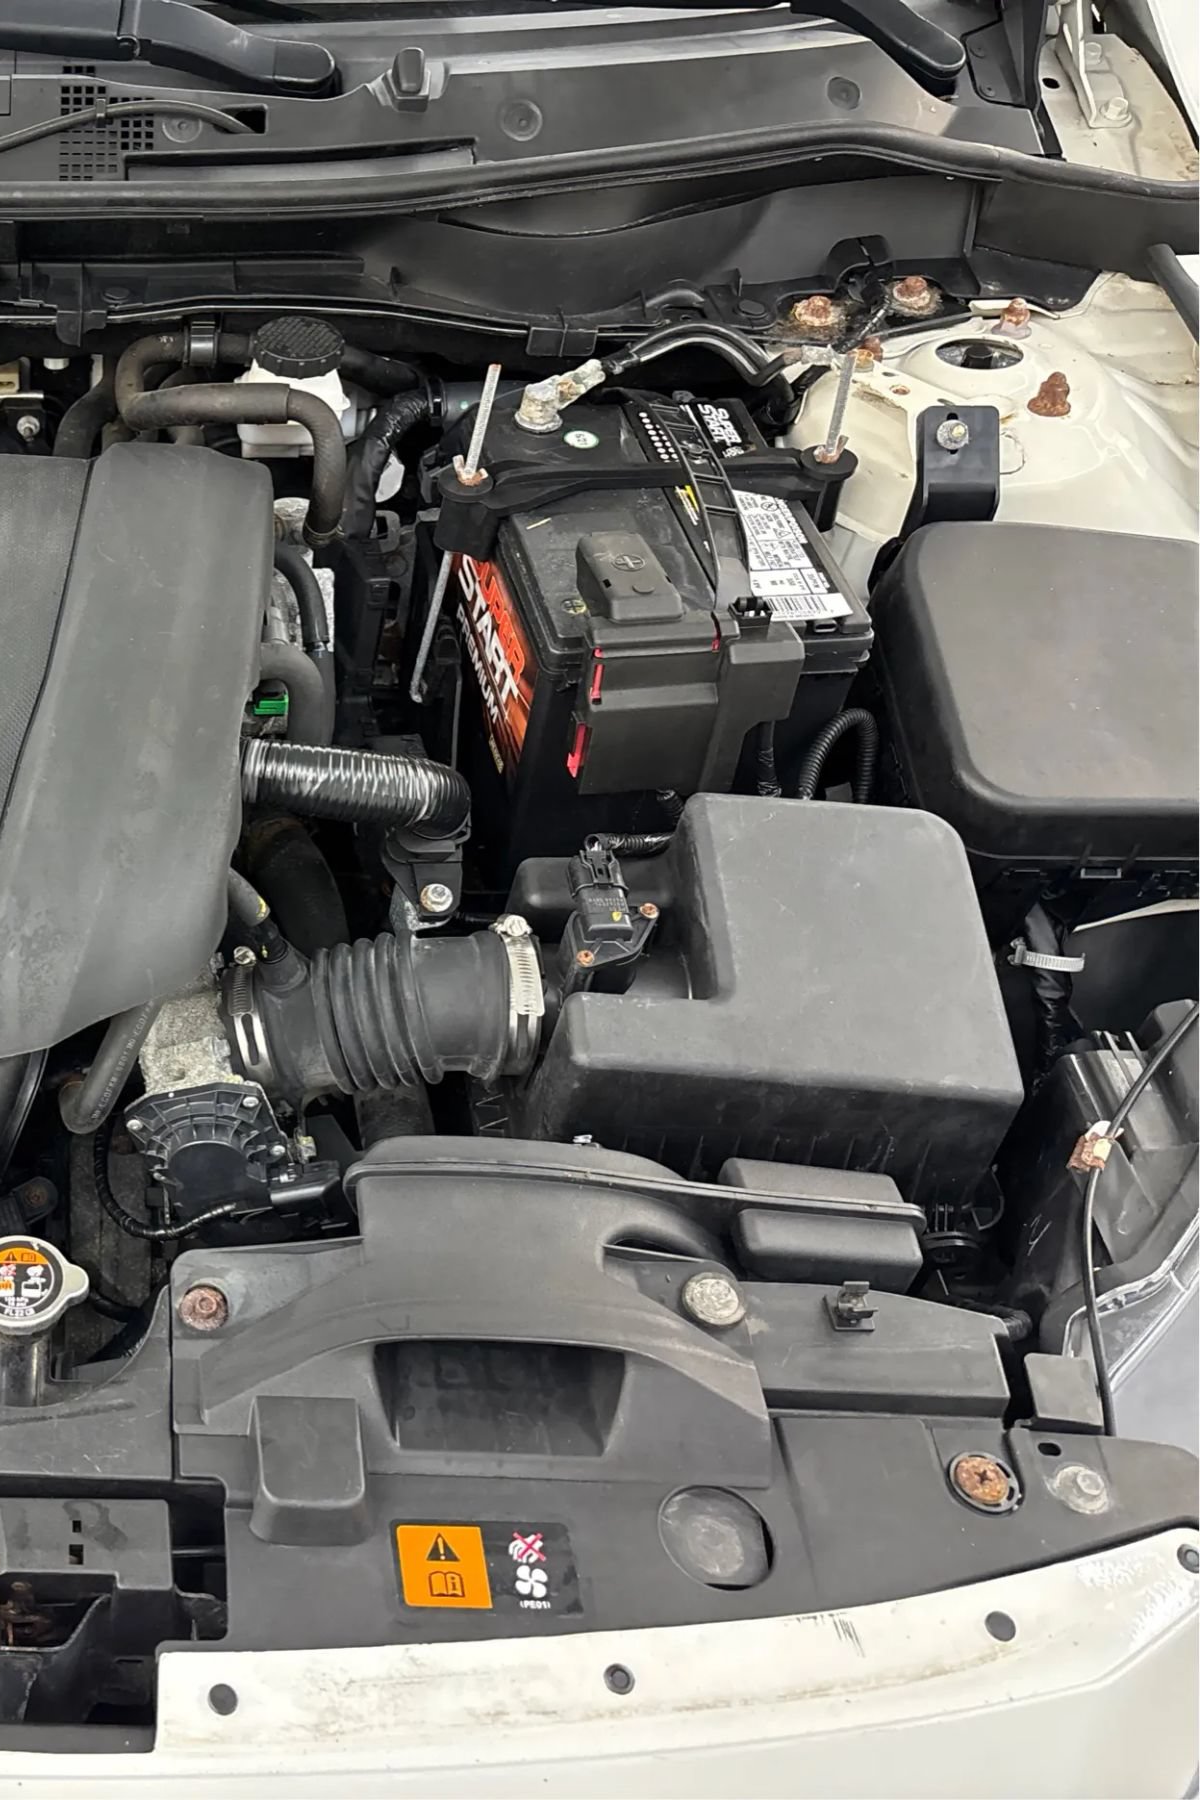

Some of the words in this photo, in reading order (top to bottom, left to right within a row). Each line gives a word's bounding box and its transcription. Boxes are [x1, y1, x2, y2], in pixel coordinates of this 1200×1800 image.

[697, 403, 726, 443] START
[714, 407, 743, 447] SUPER
[456, 602, 499, 724] PREMIUM
[458, 553, 519, 704] START
